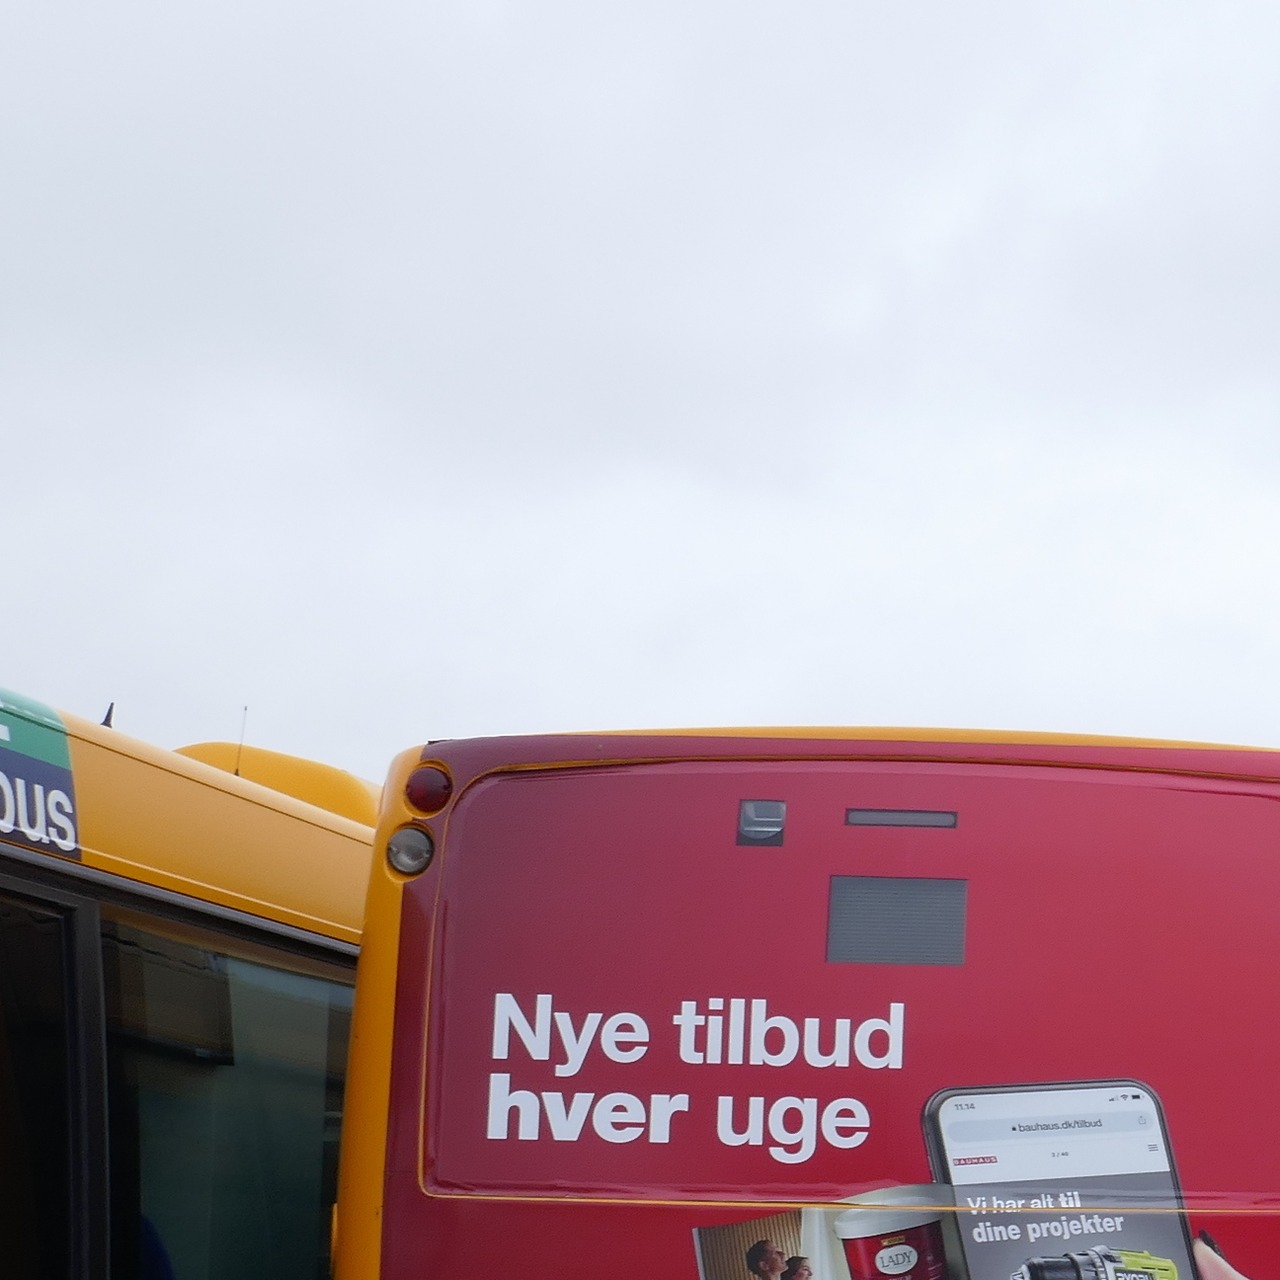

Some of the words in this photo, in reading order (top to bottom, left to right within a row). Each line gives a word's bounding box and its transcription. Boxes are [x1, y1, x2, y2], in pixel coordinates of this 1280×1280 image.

[491, 993, 650, 1078] Nye
[674, 998, 905, 1069] tilbud
[487, 1073, 689, 1144] hver
[717, 1096, 870, 1165] uge
[1018, 1119, 1103, 1132] bauhaus.dk/tilbud
[953, 1156, 998, 1165] BAUHAUS
[966, 1197, 987, 1215] Vi
[992, 1197, 1025, 1213] har
[1030, 1193, 1055, 1210] alt
[1058, 1191, 1081, 1208] til
[972, 1222, 1021, 1243] dine
[1026, 1214, 1125, 1243] projekter
[880, 1250, 913, 1269] LADY
